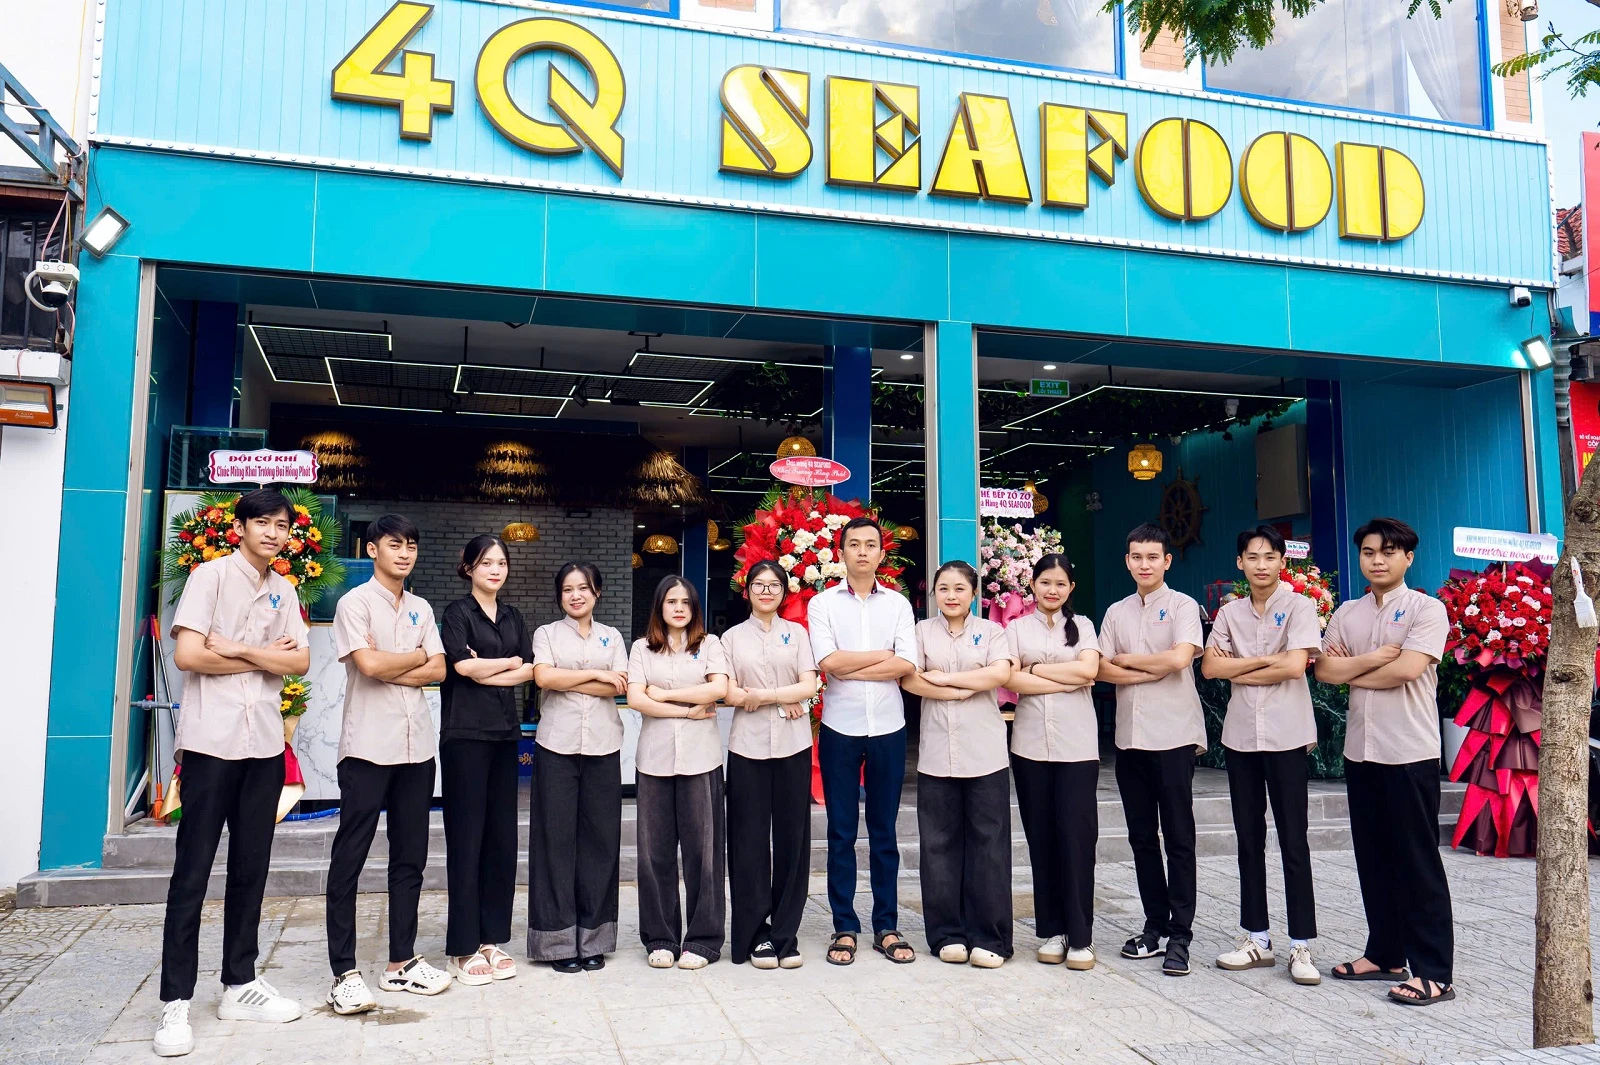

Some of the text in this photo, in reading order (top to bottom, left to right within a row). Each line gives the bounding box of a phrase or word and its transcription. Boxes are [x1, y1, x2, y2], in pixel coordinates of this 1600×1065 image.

[331, 0, 1425, 241] 4Q SEAFOOD
[1040, 381, 1060, 389] EXIT
[229, 454, 251, 463] ĐỘI
[275, 454, 298, 462] KHÍ
[814, 461, 832, 469] SEAFOOD
[216, 465, 230, 477] Chúc
[230, 465, 244, 480] Mừng
[245, 465, 257, 477] Khai
[257, 465, 275, 480] Trương
[285, 463, 298, 480] Hồng
[298, 465, 311, 477] Phát
[992, 488, 1006, 499] BẾP
[999, 500, 1007, 509] 4Q
[1008, 500, 1032, 509] SEAFOOD
[1456, 546, 1476, 554] KHAI
[1476, 547, 1508, 557] TRƯƠNG
